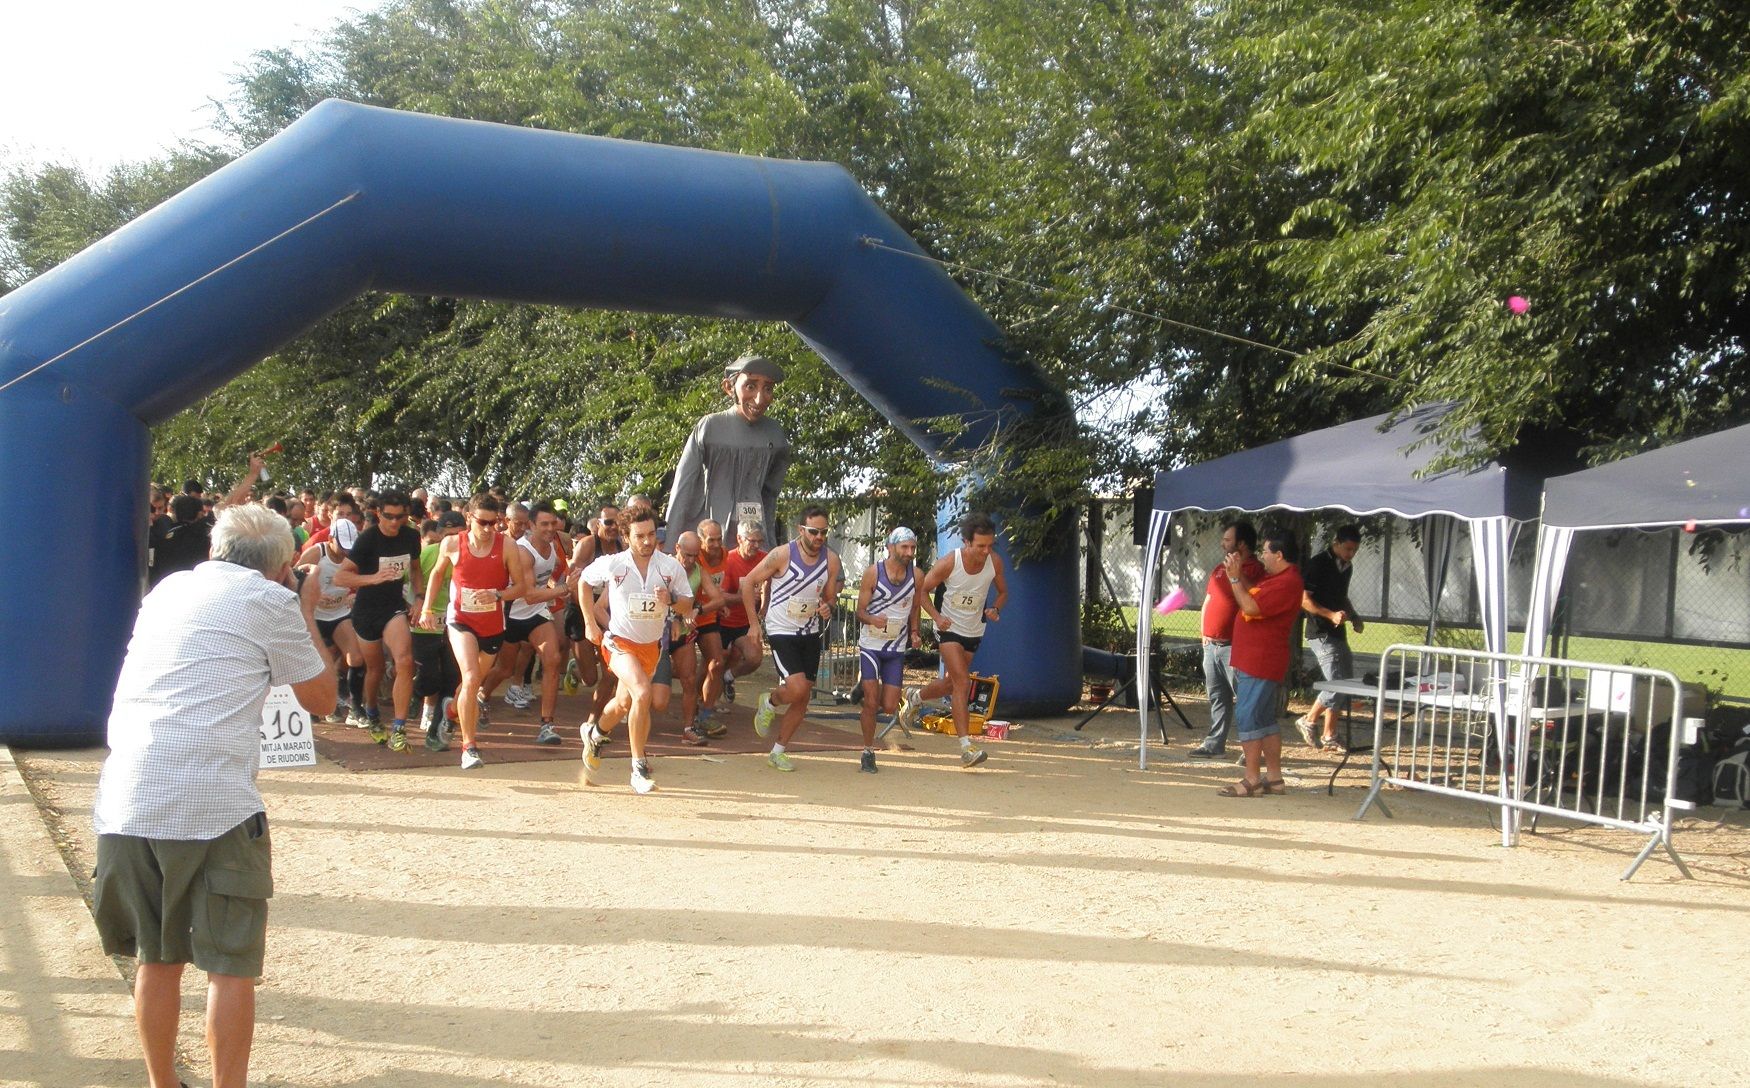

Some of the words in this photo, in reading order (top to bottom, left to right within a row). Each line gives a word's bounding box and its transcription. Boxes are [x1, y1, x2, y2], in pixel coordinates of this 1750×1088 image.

[743, 507, 757, 515] 300
[961, 596, 973, 605] 75
[641, 601, 655, 612] 12
[801, 603, 807, 612] 2
[261, 742, 282, 752] MITJA
[267, 755, 277, 764] DE
[278, 752, 310, 763] RIUDOMS
